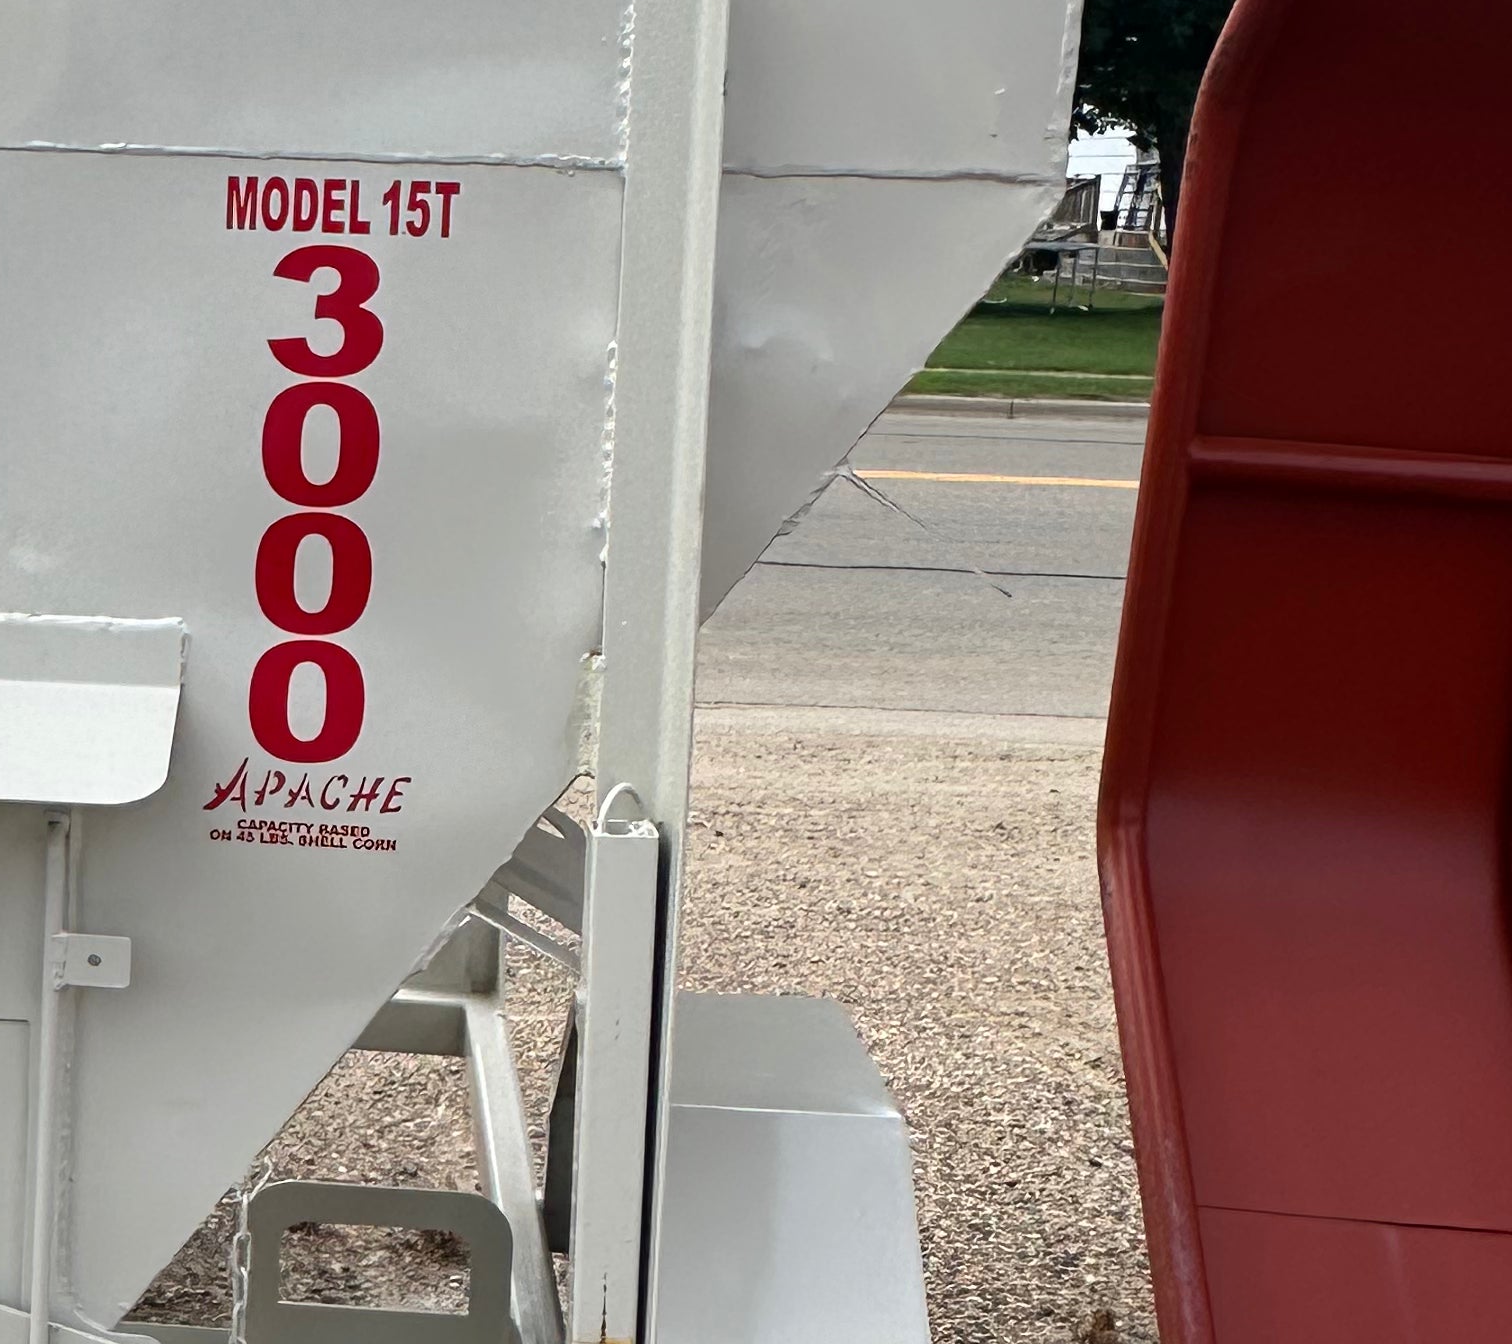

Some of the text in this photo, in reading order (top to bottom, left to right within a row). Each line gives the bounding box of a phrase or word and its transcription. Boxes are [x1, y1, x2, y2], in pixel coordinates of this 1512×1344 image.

[226, 176, 371, 235] MODEL
[248, 244, 384, 764] 3000
[203, 757, 412, 814] APACHE
[210, 829, 231, 841] ON
[298, 835, 348, 848] SHELL
[352, 837, 397, 851] CORN
[237, 819, 370, 837] CAPACITY BASED
